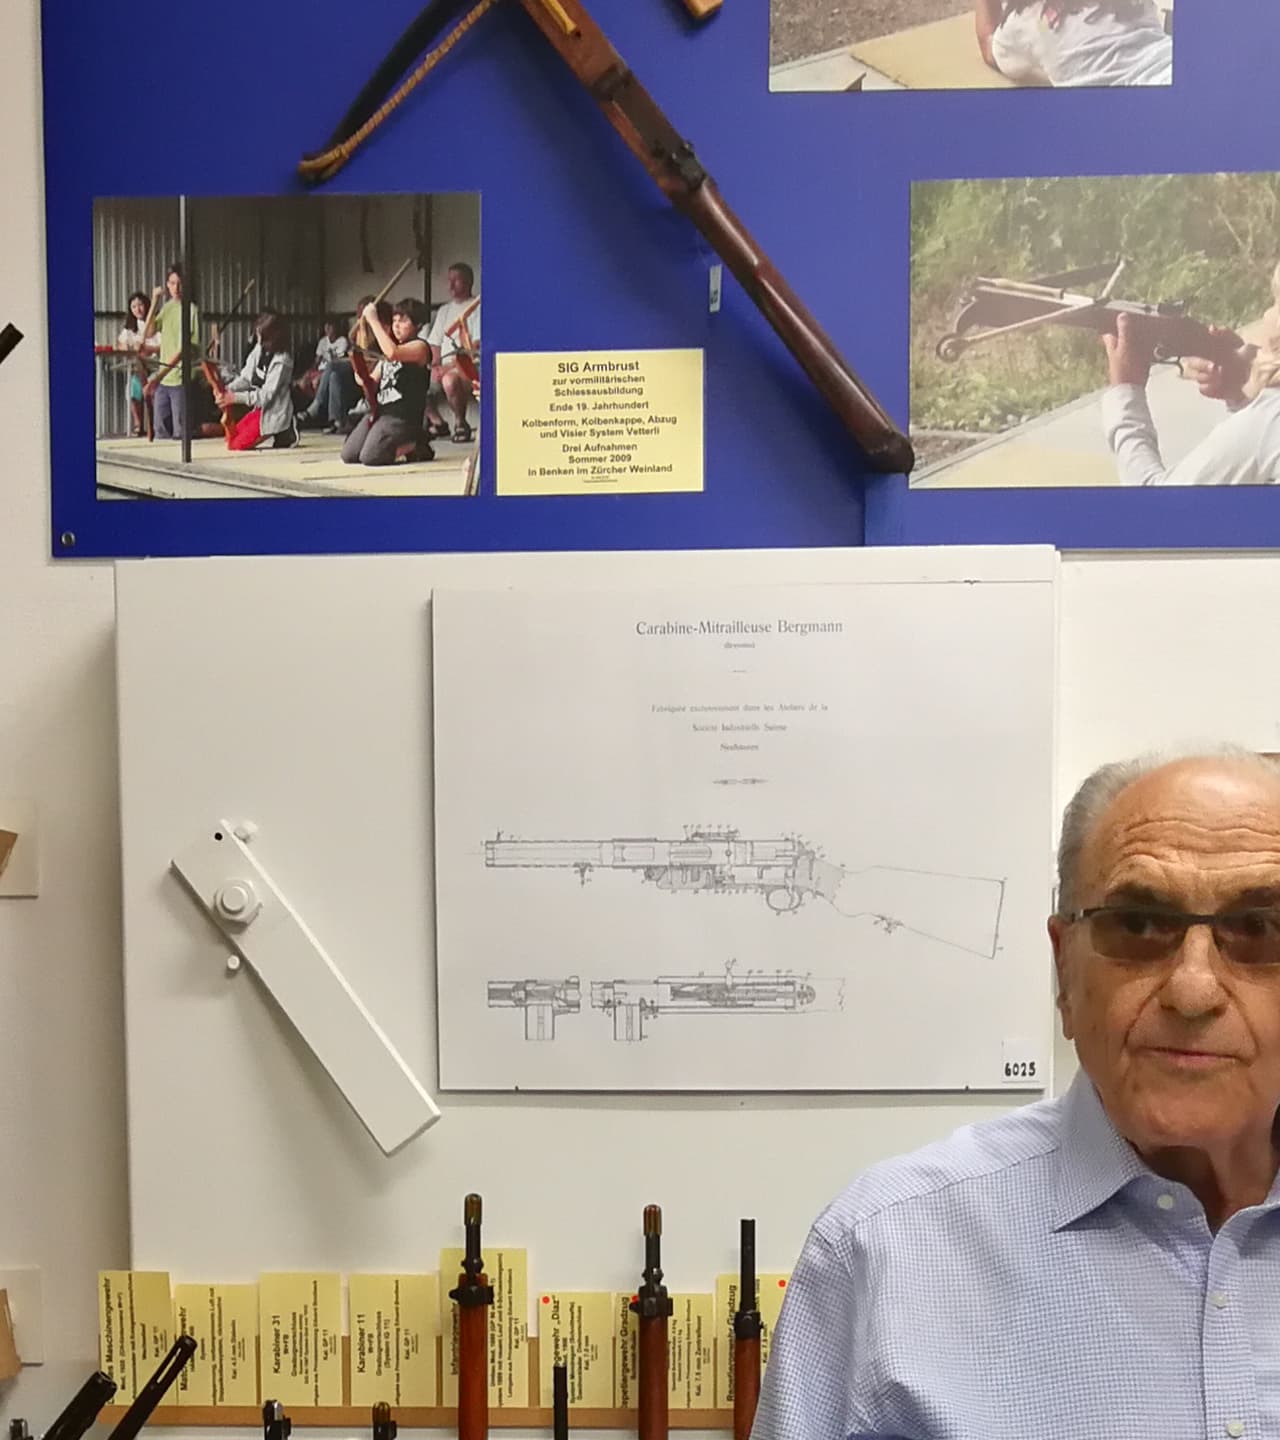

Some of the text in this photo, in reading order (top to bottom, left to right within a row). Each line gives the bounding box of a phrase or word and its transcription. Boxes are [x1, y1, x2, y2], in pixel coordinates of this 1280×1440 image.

[558, 361, 639, 373] SIG Armbrust
[570, 375, 645, 384] vormilitärischen
[554, 387, 643, 397] Schiessausbildung
[549, 401, 648, 412] Ende 19. Jahrhundert
[522, 416, 677, 427] Kolbenform, Kolbenkappe, Abzug
[540, 427, 659, 438] und Visier System Vetterli
[562, 443, 637, 453] Drei Aufnahmen
[569, 454, 631, 464] Sommer 2009
[540, 467, 574, 476] Benken
[591, 466, 627, 475] Zürcher
[630, 464, 672, 473] Weinland
[636, 619, 843, 635] Carabine-Mitrailleuse Bergmann
[1004, 1062, 1036, 1077] 6025
[102, 1277, 114, 1362] Maschinengewehr
[620, 1297, 630, 1337] Gradzug
[272, 1315, 280, 1373] Karabiner 31
[357, 1314, 366, 1373] Karabiner 11
